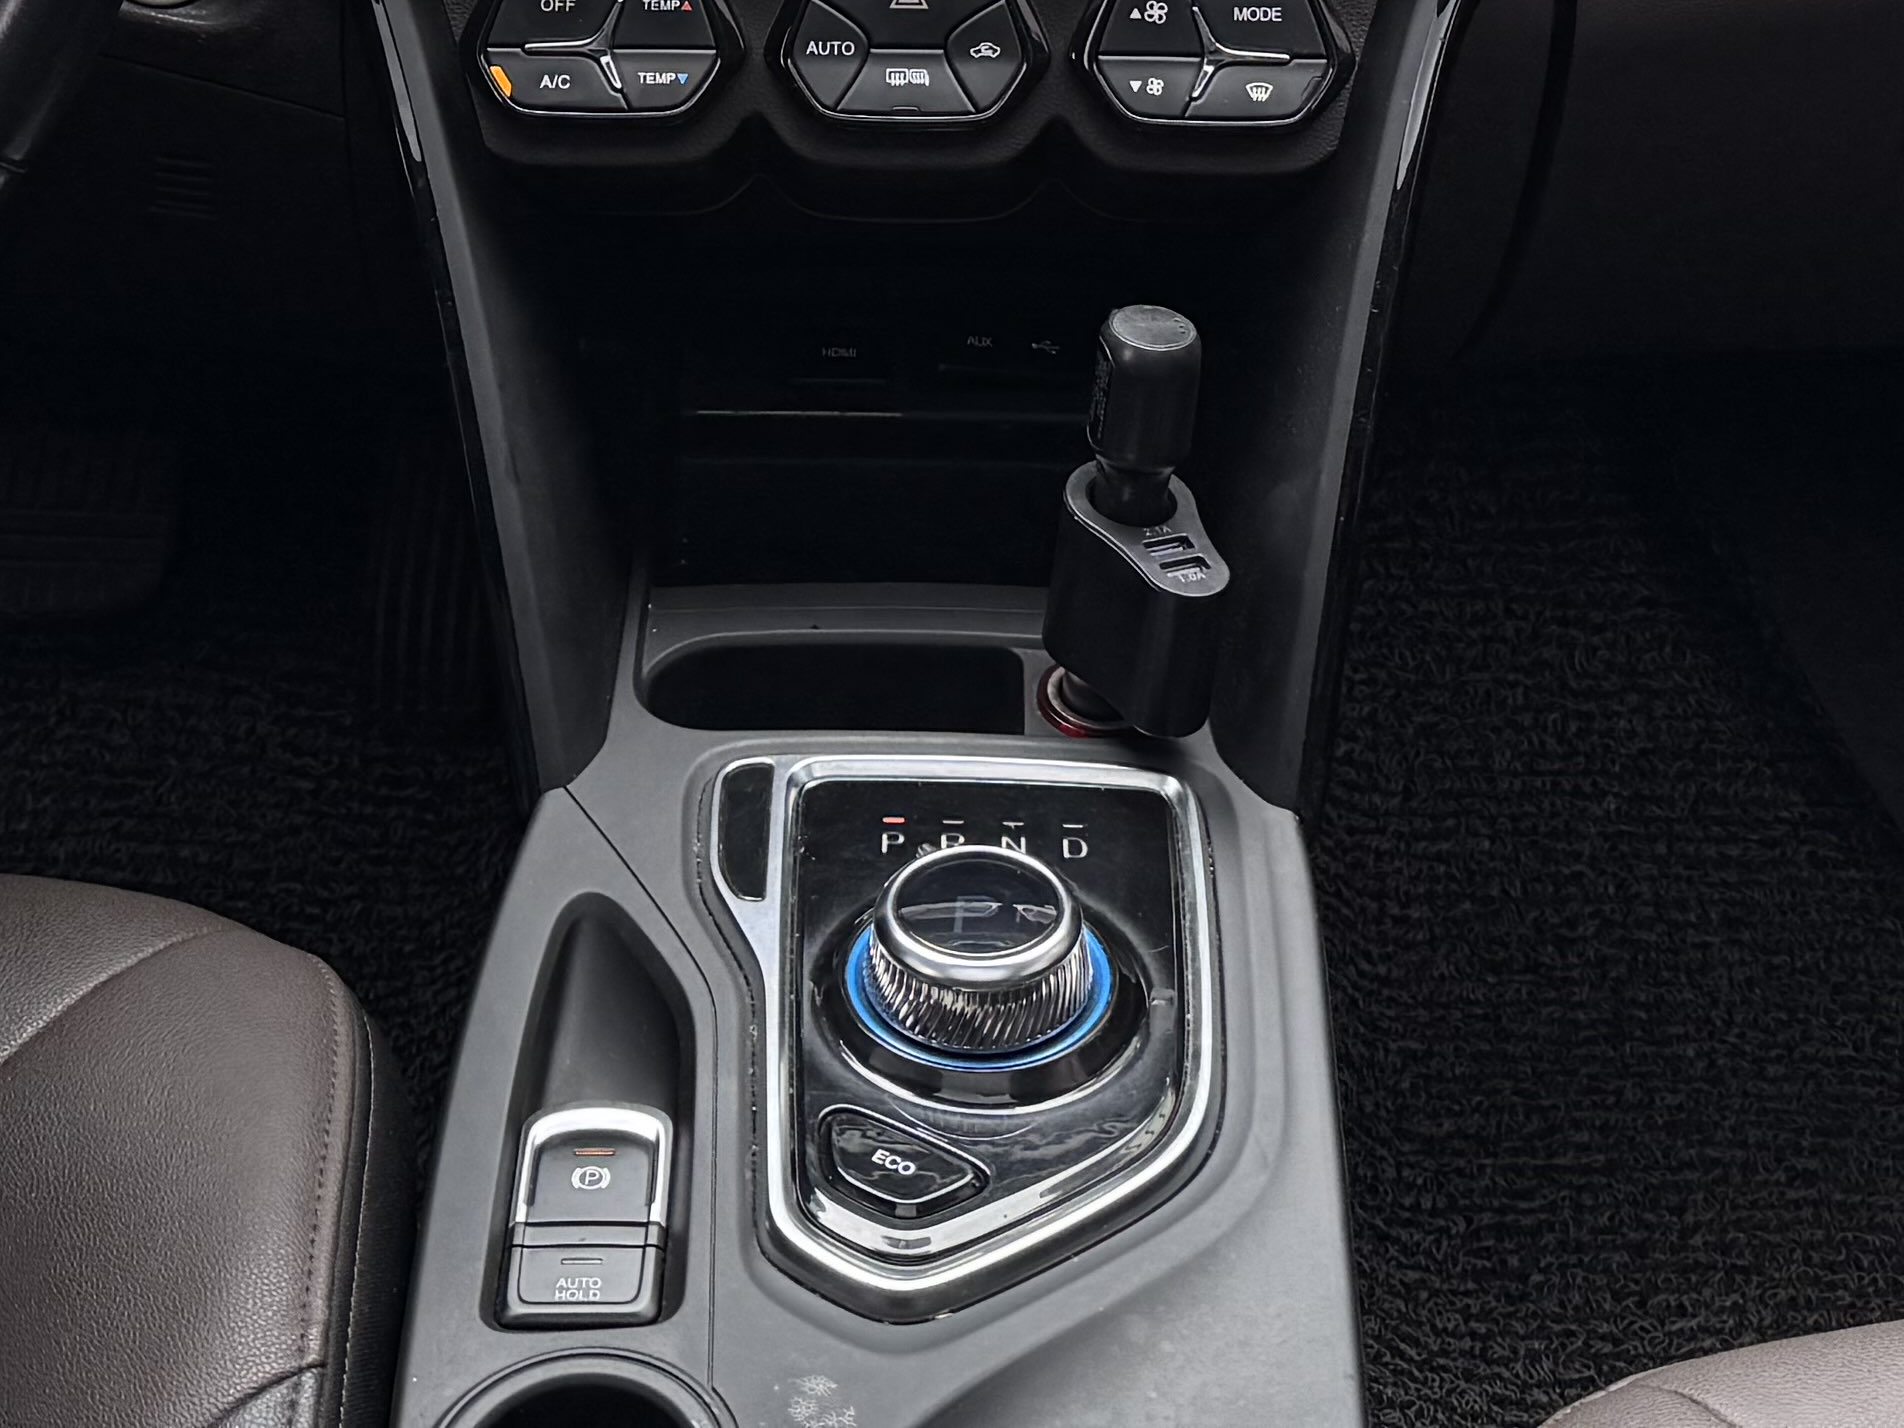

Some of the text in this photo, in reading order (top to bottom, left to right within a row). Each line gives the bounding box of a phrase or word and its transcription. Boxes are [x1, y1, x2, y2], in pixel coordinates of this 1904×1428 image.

[1232, 5, 1283, 24] MODE
[805, 40, 856, 58] AUTO
[538, 72, 572, 91] A/C
[637, 71, 677, 86] TEMP
[965, 335, 994, 348] AUX
[880, 831, 907, 855] P
[1001, 836, 1027, 855] N
[1061, 836, 1090, 860] D
[870, 1147, 918, 1177] ECO
[555, 1277, 602, 1290] AUTO
[554, 1289, 602, 1302] HOLD
